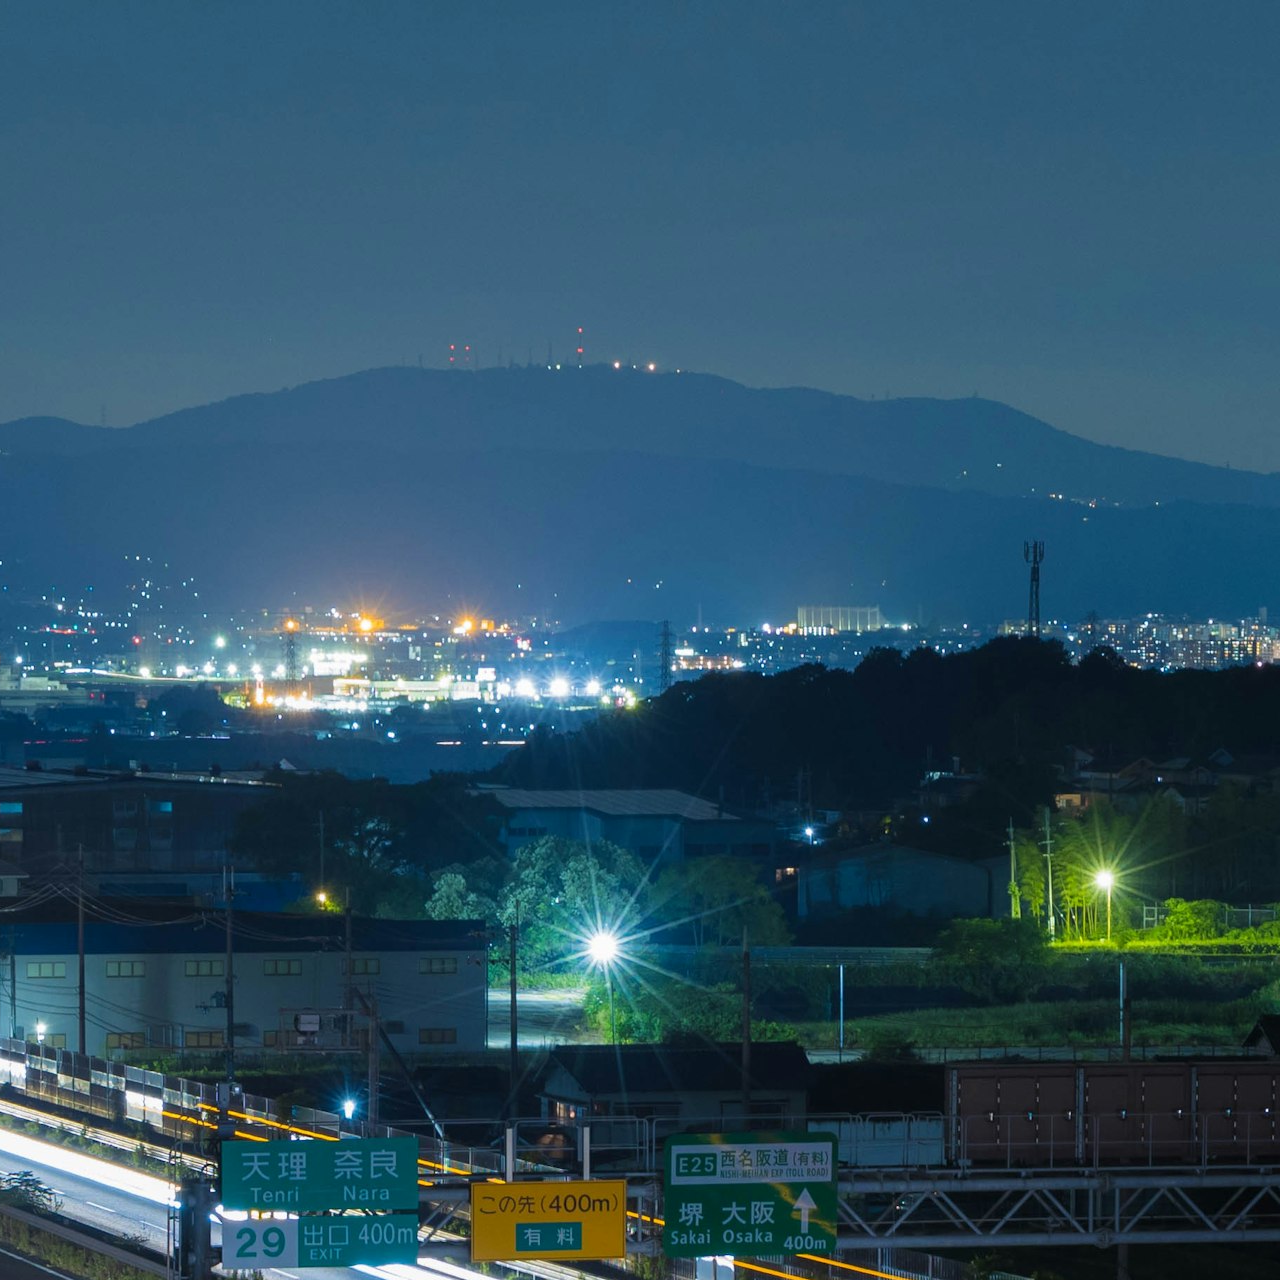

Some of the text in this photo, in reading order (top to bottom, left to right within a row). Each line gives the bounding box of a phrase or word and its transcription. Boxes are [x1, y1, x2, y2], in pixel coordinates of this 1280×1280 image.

[241, 1150, 399, 1181] 天理 奈良
[679, 1157, 714, 1173] E25
[250, 1186, 390, 1203] Tenri Nara
[679, 1201, 775, 1226] 堺 大阪
[236, 1226, 286, 1258] 29
[304, 1223, 414, 1246] 出口 400m
[524, 1227, 574, 1246] 有料
[671, 1228, 773, 1245] Sakai Osaka
[784, 1236, 826, 1250] 400m
[310, 1248, 342, 1260] EXIT
